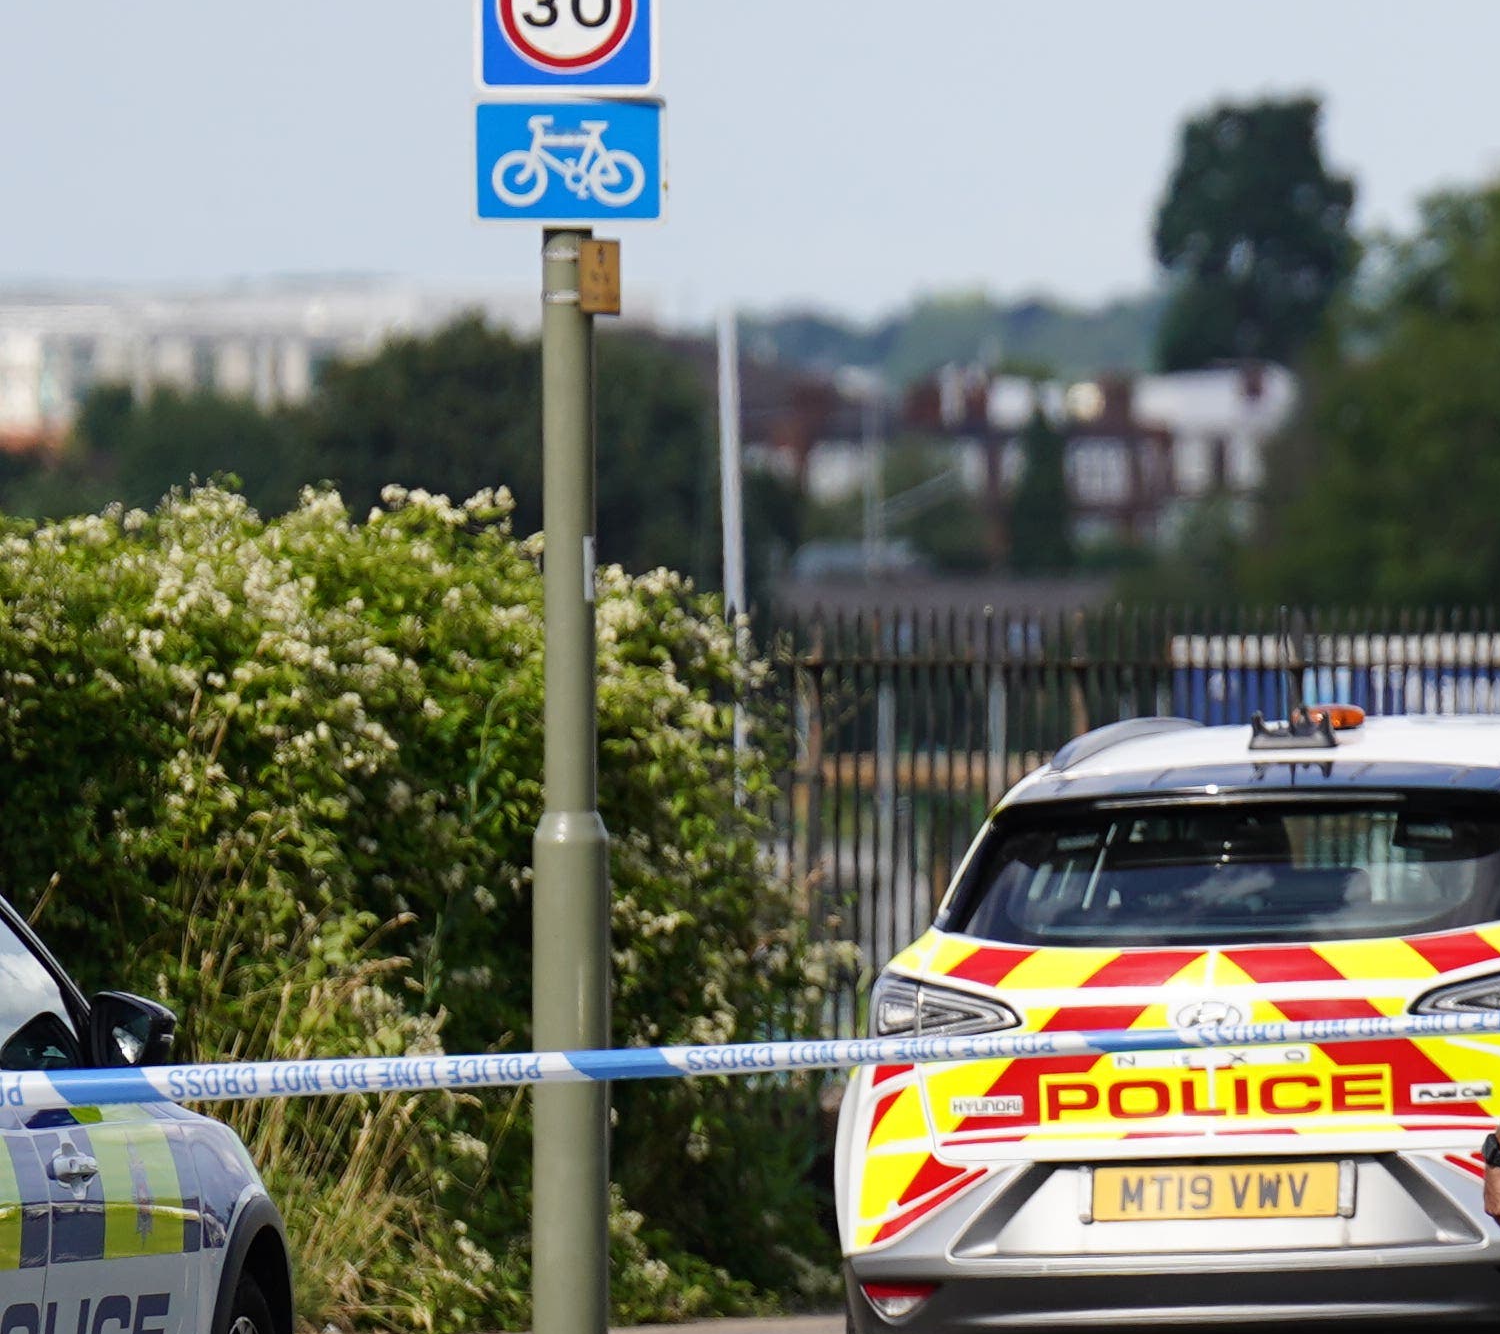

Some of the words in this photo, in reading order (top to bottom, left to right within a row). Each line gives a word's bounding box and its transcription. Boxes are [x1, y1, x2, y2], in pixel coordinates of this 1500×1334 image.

[686, 1045, 775, 1071] CROSS
[787, 1042, 839, 1066] NOT
[847, 1040, 885, 1063] DO
[894, 1038, 949, 1060] LINE
[957, 1033, 1058, 1056] POLICE
[269, 1063, 321, 1094] NOT
[331, 1063, 368, 1092] DO
[377, 1059, 437, 1088] LINE
[446, 1055, 545, 1082] POLICE
[168, 1066, 259, 1099] CROSS
[953, 1099, 1021, 1113] HYUNDAI
[1046, 1072, 1388, 1121] POLICE
[1119, 1173, 1213, 1212] MT19
[1230, 1172, 1309, 1209] VWV
